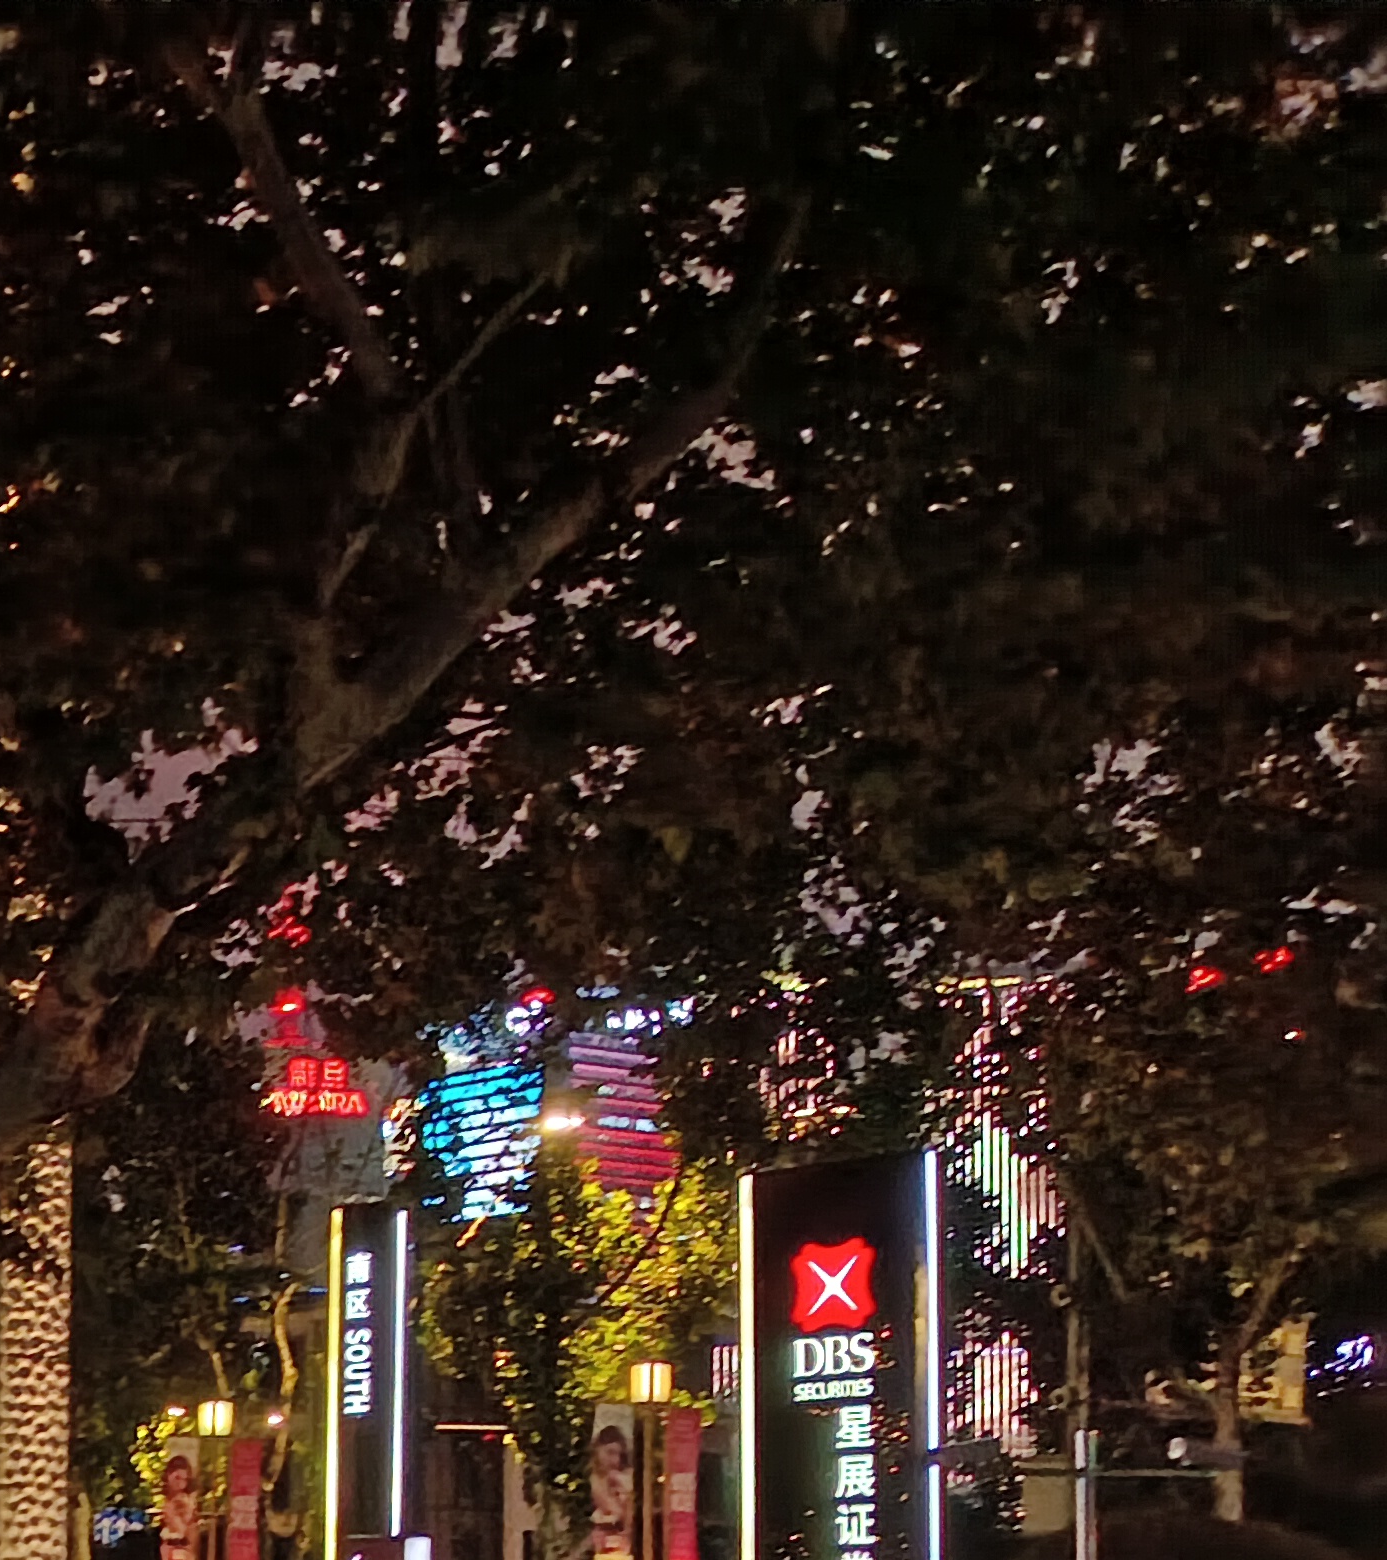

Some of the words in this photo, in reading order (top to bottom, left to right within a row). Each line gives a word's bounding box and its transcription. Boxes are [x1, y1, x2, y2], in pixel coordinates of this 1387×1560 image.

[343, 1328, 373, 1416] SOUTH
[792, 1331, 876, 1378] DBS
[792, 1378, 875, 1402] SECURITIES
